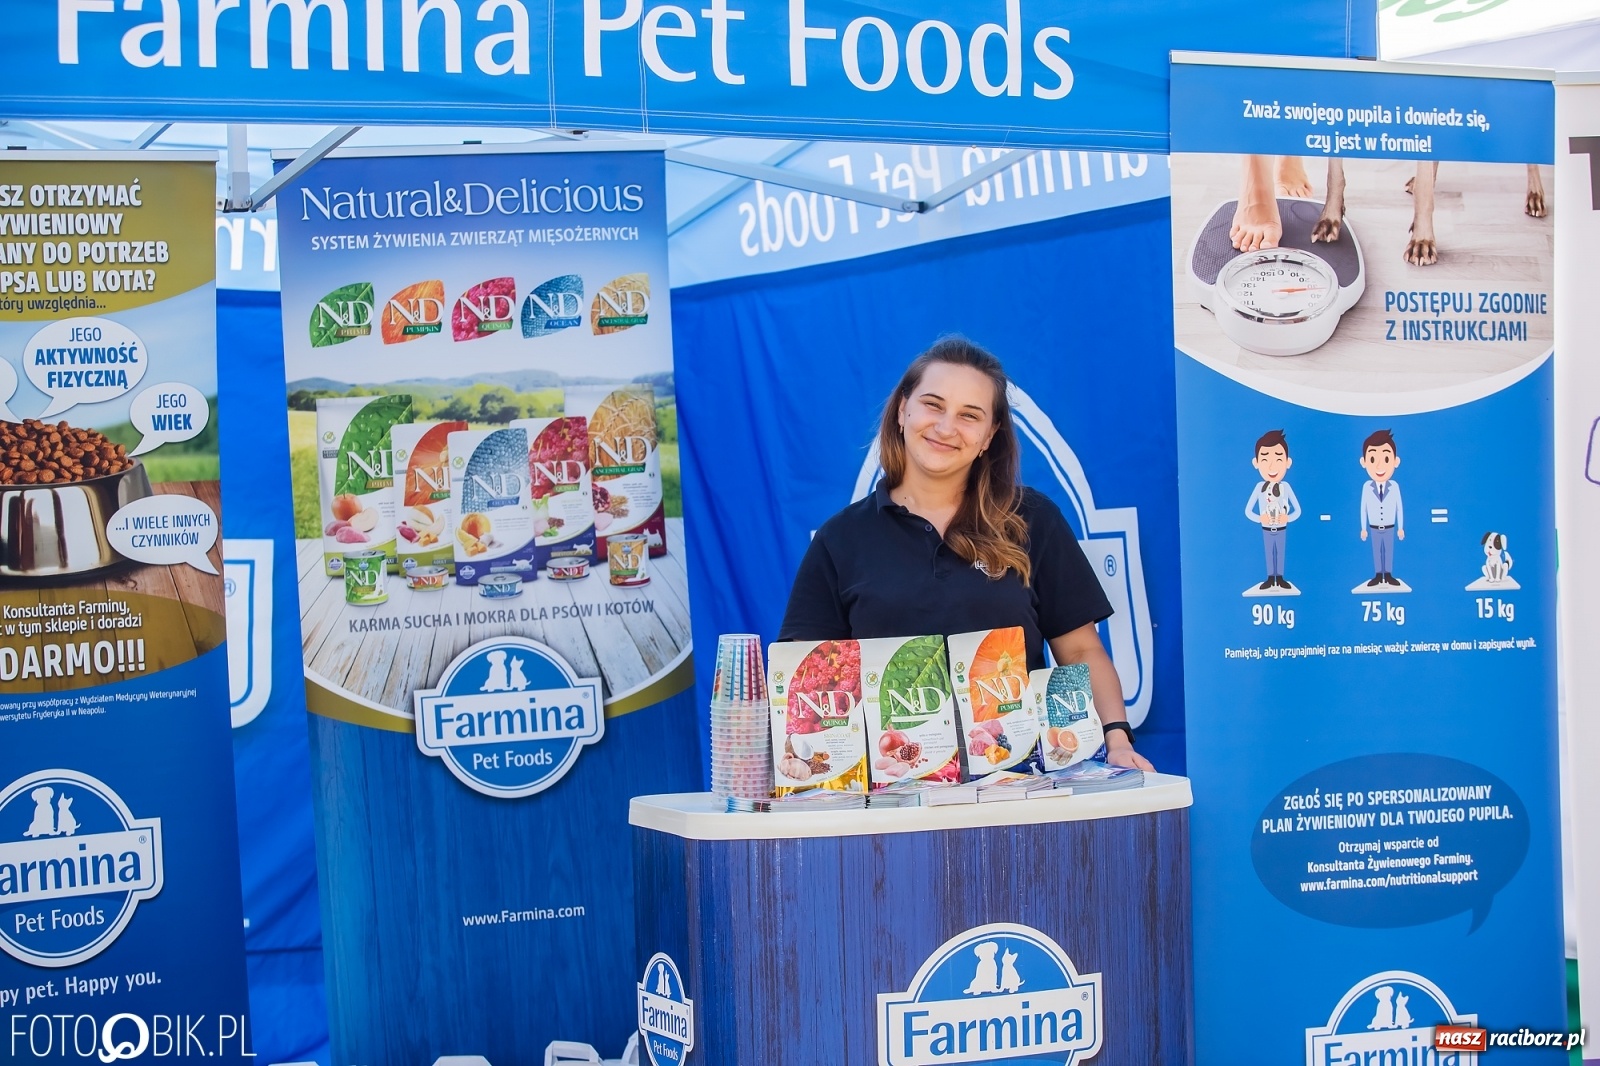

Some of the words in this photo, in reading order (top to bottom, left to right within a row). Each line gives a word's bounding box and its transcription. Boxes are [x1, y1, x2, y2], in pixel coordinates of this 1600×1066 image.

[583, 0, 746, 86] Pet
[788, 0, 1075, 100] Foods
[1243, 99, 1280, 119] Zważ
[1284, 103, 1344, 125] swojego
[1347, 105, 1392, 127] pupila
[1396, 106, 1400, 124] i
[1404, 106, 1463, 127] dowiedz
[1466, 109, 1490, 132] się,
[1306, 134, 1331, 153] czy
[1334, 131, 1362, 153] jest
[1364, 136, 1377, 151] w
[1380, 133, 1432, 153] formie!
[30, 178, 142, 207] OTRZYMAĆ
[300, 177, 644, 222] Natural&Delicious
[311, 234, 370, 251] SYSTEM
[373, 230, 447, 249] ŻYWIENIA
[450, 229, 525, 248] ZWIERZĄT
[528, 224, 639, 247] MIĘSOŻERNYCH
[43, 241, 72, 264] DO
[78, 241, 169, 263] POTRZEB
[0, 271, 40, 293] PSA
[46, 270, 87, 292] LUB
[93, 269, 156, 293] KOTA?
[27, 295, 106, 313] uwzględnia...
[316, 299, 374, 328] N&D
[388, 296, 444, 325] N&D
[459, 293, 516, 323] N&D
[527, 291, 584, 319] N&D
[597, 289, 650, 317] N&D
[1385, 291, 1472, 317] POSTĘPUJ
[1478, 292, 1547, 315] ZGODNIE
[69, 327, 102, 342] JEGO
[550, 318, 579, 327] OCEAN
[1385, 319, 1397, 341] Z
[1402, 320, 1527, 342] INSTRUKCJAMI
[35, 341, 138, 366] AKTYWNOŚĆ
[47, 369, 129, 390] FIZYCZNĄ
[156, 393, 187, 409] JEGO
[151, 413, 192, 432] WIEK
[593, 435, 653, 467] N&D
[533, 459, 587, 486] N&D
[132, 515, 169, 530] WIELE
[172, 513, 211, 528] INNYCH
[131, 530, 200, 548] CZYNNIKÓW
[3, 602, 76, 620] Konsultanta
[78, 599, 130, 617] Farminy,
[349, 617, 401, 633] KARMA
[404, 612, 452, 630] SUCHA
[456, 612, 460, 626] I
[464, 608, 517, 626] MOKRA
[520, 605, 548, 623] DLA
[552, 601, 593, 620] PSÓW
[597, 603, 601, 616] I
[605, 598, 655, 616] KOTÓW
[1252, 604, 1274, 626] 90
[1277, 605, 1295, 629] kg
[1361, 601, 1382, 622] 75
[1386, 602, 1405, 626] kg
[1476, 597, 1493, 619] 15
[1497, 599, 1515, 622] kg
[5, 624, 16, 635] w
[18, 620, 42, 638] tym
[45, 615, 87, 637] sklepie
[90, 616, 94, 629] i
[97, 613, 142, 629] doradzi
[0, 638, 146, 681] DARMO!!!
[1224, 647, 1262, 660] Pamiętaj,
[1264, 647, 1279, 659] aby
[1280, 644, 1326, 659] przynajmniej
[1328, 645, 1340, 655] raz
[1342, 645, 1352, 654] na
[1354, 642, 1382, 656] miesiąc
[1384, 640, 1409, 655] ważyć
[1410, 641, 1440, 654] zwierzę
[1441, 642, 1449, 651] w
[1450, 640, 1472, 651] domu
[1478, 636, 1515, 652] zapisywać
[22, 701, 37, 710] przy
[37, 697, 74, 709] współpracy
[79, 694, 115, 706] Wydziałem
[115, 692, 148, 703] Medycyny
[149, 688, 197, 701] Weterynaryjnej
[886, 686, 947, 715] N&D
[975, 674, 1027, 706] N&D
[33, 708, 65, 720] Fryderyka
[78, 706, 106, 717] Neapolu.
[795, 690, 857, 719] N&D
[433, 697, 585, 741] Farmina
[822, 719, 847, 727] QUINOA
[472, 752, 499, 771] Pet
[505, 748, 553, 768] Foods
[1284, 787, 1321, 811] ZGŁOŚ
[1324, 793, 1343, 811] SIĘ
[1347, 792, 1364, 807] PO
[1367, 785, 1492, 806] SPERSONALIZOWANY
[1262, 817, 1293, 834] PLAN
[1296, 812, 1376, 832] ŻYWIENIOWY
[1380, 811, 1404, 827] DLA
[1408, 807, 1465, 825] TWOJEGO
[1469, 805, 1514, 821] PUPILA.
[1338, 840, 1381, 855] Otrzymaj
[1383, 837, 1425, 853] wsparcie
[1427, 836, 1439, 848] od
[1307, 858, 1365, 874] Konsultanta
[1367, 854, 1431, 872] Żywienowego
[1433, 853, 1474, 869] Farminy.
[1300, 869, 1478, 892] www.farmina.com/nutritionalsupport
[14, 912, 45, 934] Pet
[51, 905, 105, 930] Foods
[462, 905, 585, 927] www.Farmina.com
[25, 980, 59, 1004] pet.
[65, 973, 119, 996] Happy
[125, 971, 162, 992] you.
[641, 995, 688, 1039] Farmina
[903, 1000, 1083, 1058] Farmina
[653, 1040, 662, 1055] Pet
[663, 1043, 679, 1061] Foods
